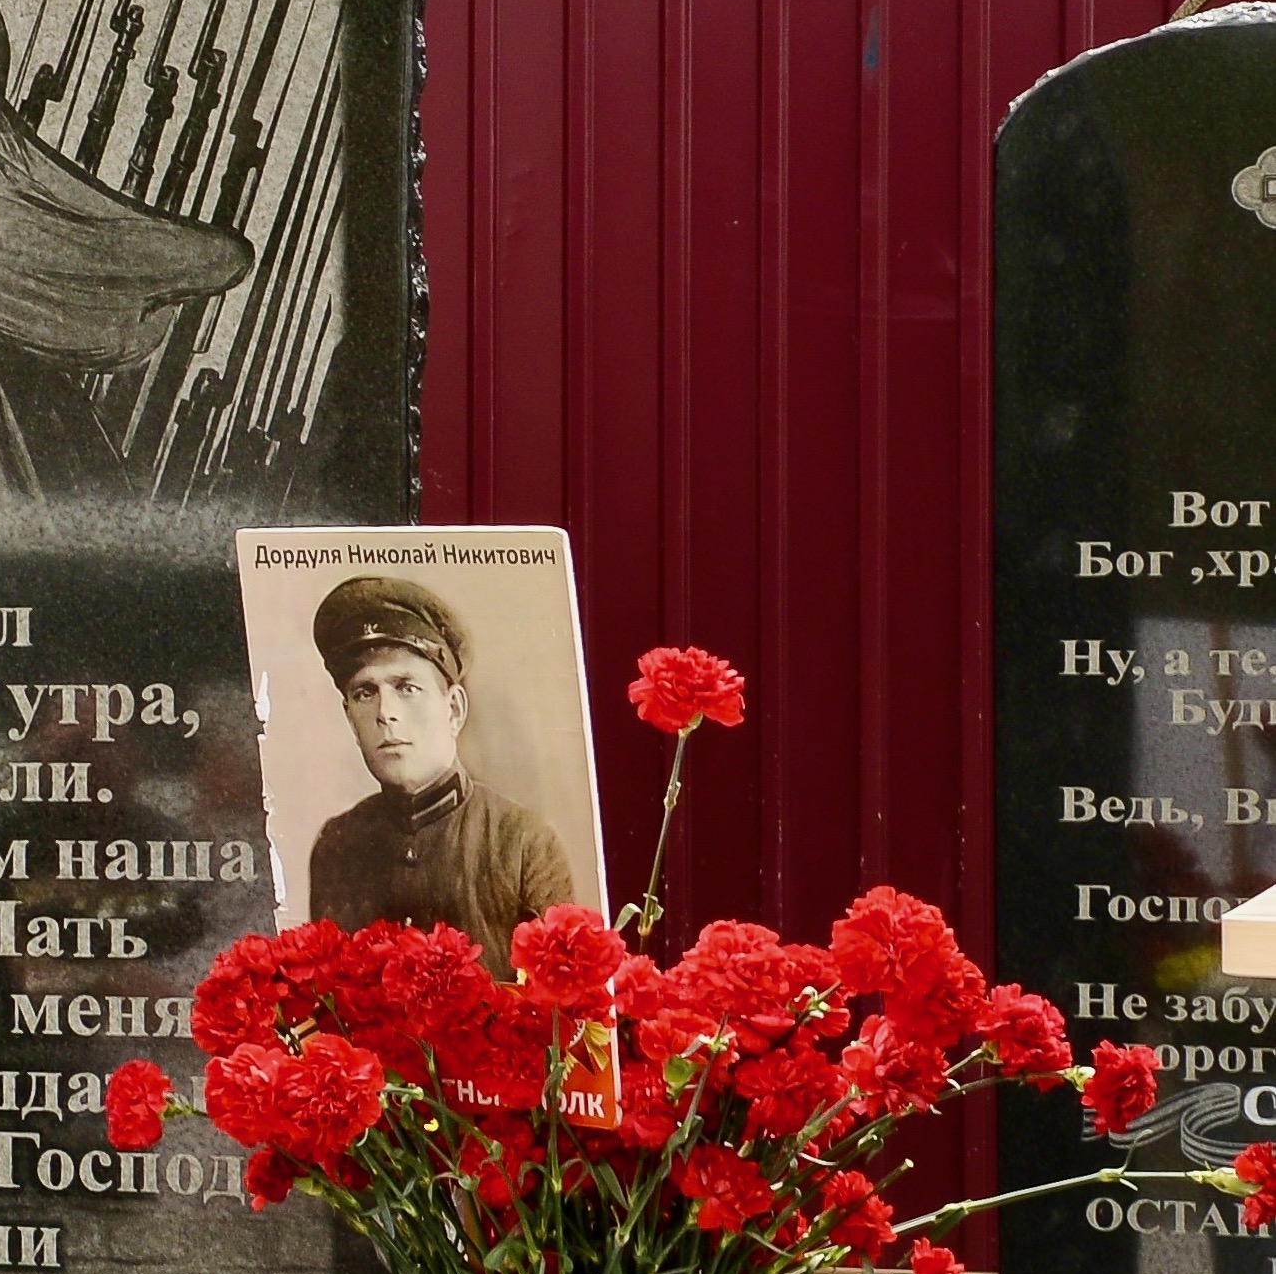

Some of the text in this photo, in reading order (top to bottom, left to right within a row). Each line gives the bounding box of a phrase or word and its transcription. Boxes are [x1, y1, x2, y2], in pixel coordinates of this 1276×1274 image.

[1168, 491, 1270, 527] Вот
[254, 542, 556, 568] Дордуля Николай Никитович
[1075, 541, 1276, 588] Бог ,хр
[1059, 639, 1145, 686] Ну,
[1164, 649, 1190, 676] а
[7, 684, 201, 741] утра,
[1168, 689, 1276, 735] Буд
[1059, 785, 1204, 829] Ведь,
[56, 837, 256, 882] наша
[1073, 884, 1248, 923] Госпо
[1073, 982, 1148, 1021] Не
[1123, 1042, 1276, 1082] орог
